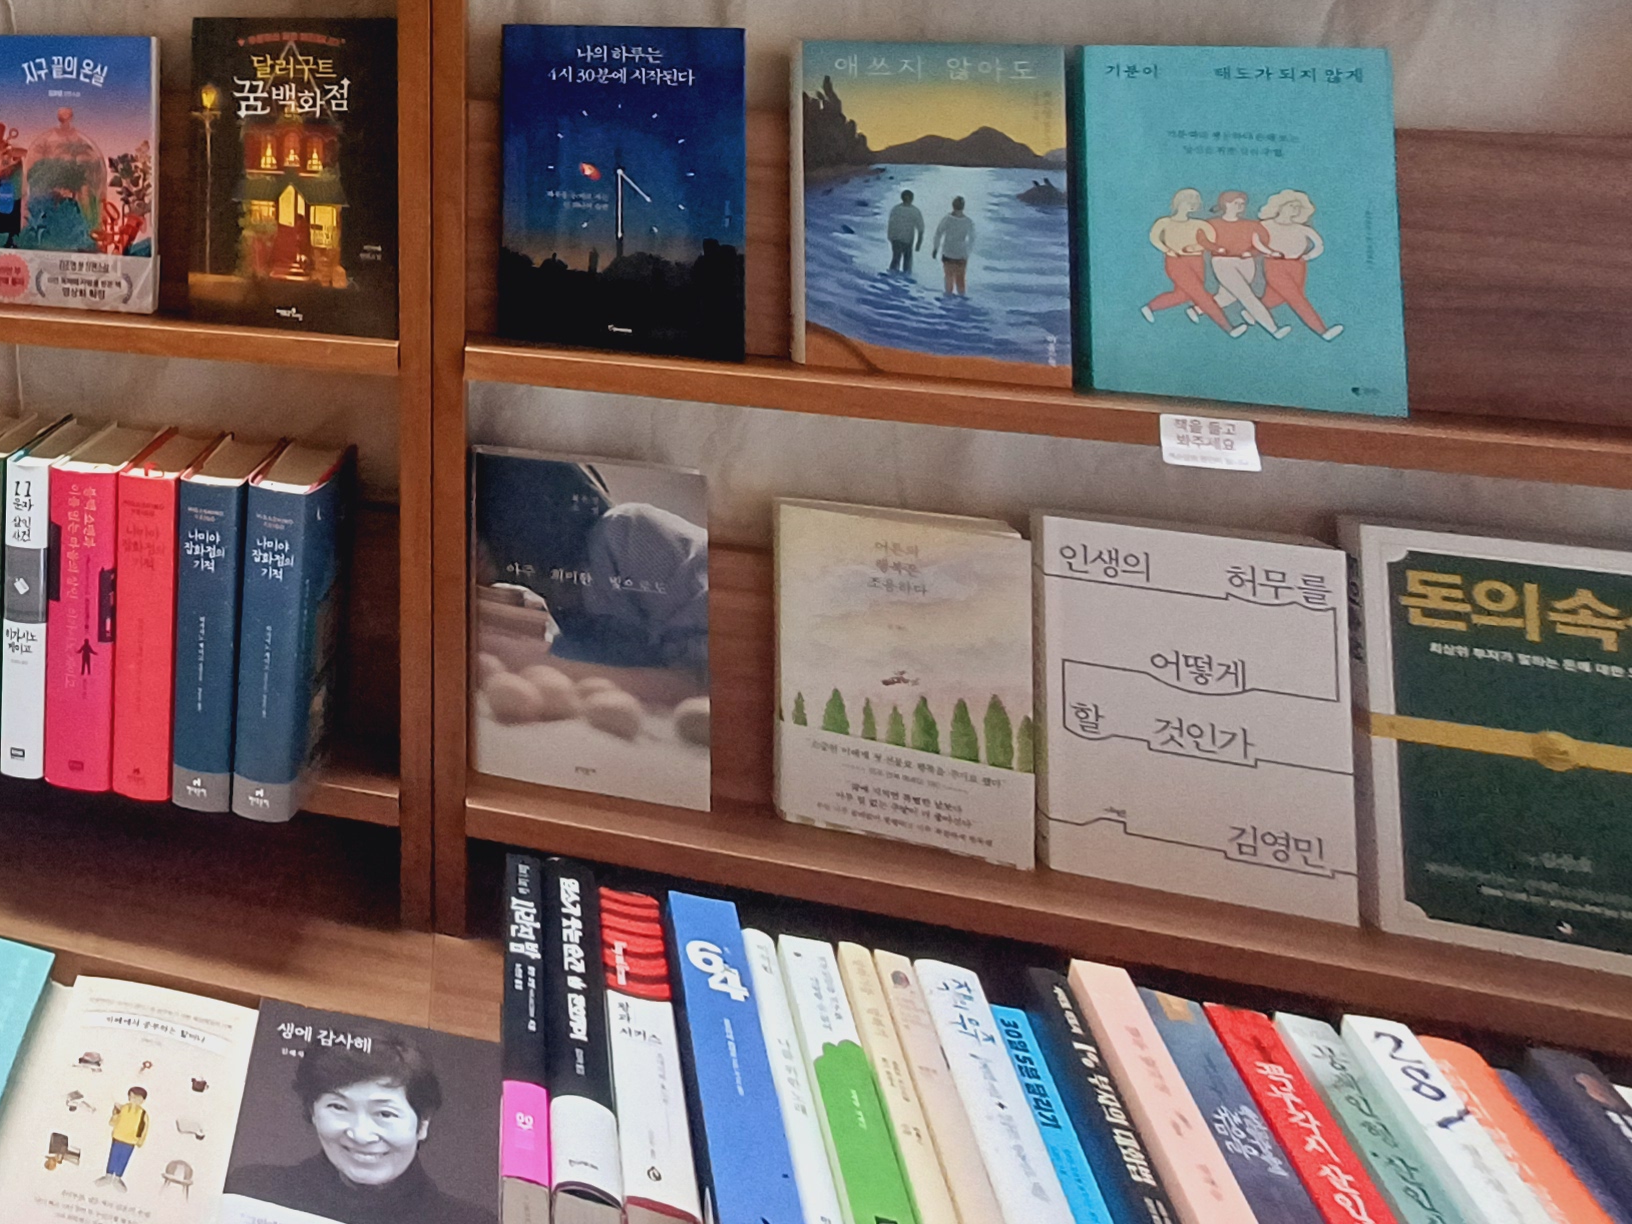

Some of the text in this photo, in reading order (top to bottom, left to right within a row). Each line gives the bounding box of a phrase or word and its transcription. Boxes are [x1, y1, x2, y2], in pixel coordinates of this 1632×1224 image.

[249, 53, 338, 80] 달러구트
[576, 45, 663, 65] 나의 하루는
[834, 53, 1039, 83] 애쓰지 않아도
[19, 55, 109, 88] 지구 끝의 온실
[575, 67, 628, 85] 30분에
[630, 68, 696, 88] 시작된다
[1104, 62, 1364, 84] 기분이 태도가 되지 않게
[232, 75, 352, 118] 꿈 백화점
[1173, 417, 1237, 436] 책을 들고
[1176, 434, 1236, 452] 봐주세요
[186, 529, 222, 545] 나미야
[254, 534, 291, 553] 나미야
[872, 538, 921, 559] 어른의
[183, 541, 226, 561] 잡화점의
[250, 549, 295, 569] 잡화점의
[1058, 541, 1153, 584] 인생의
[192, 558, 217, 574] 기적
[261, 566, 285, 582] 기적
[867, 574, 929, 598] 조용하다
[1225, 564, 1333, 609] 허무를
[1399, 568, 1632, 654] 돈의 속
[1149, 648, 1248, 694] 어떻게
[1070, 701, 1256, 762] 할 것인가
[1227, 822, 1325, 867] 김영민
[684, 939, 750, 1003] 64
[276, 1021, 374, 1055] 생에 감사해
[999, 1017, 1028, 1053] 30일
[1023, 1077, 1062, 1129] 달리기
[1072, 1039, 1101, 1070] 1%
[1087, 1072, 1128, 1128] 부자의
